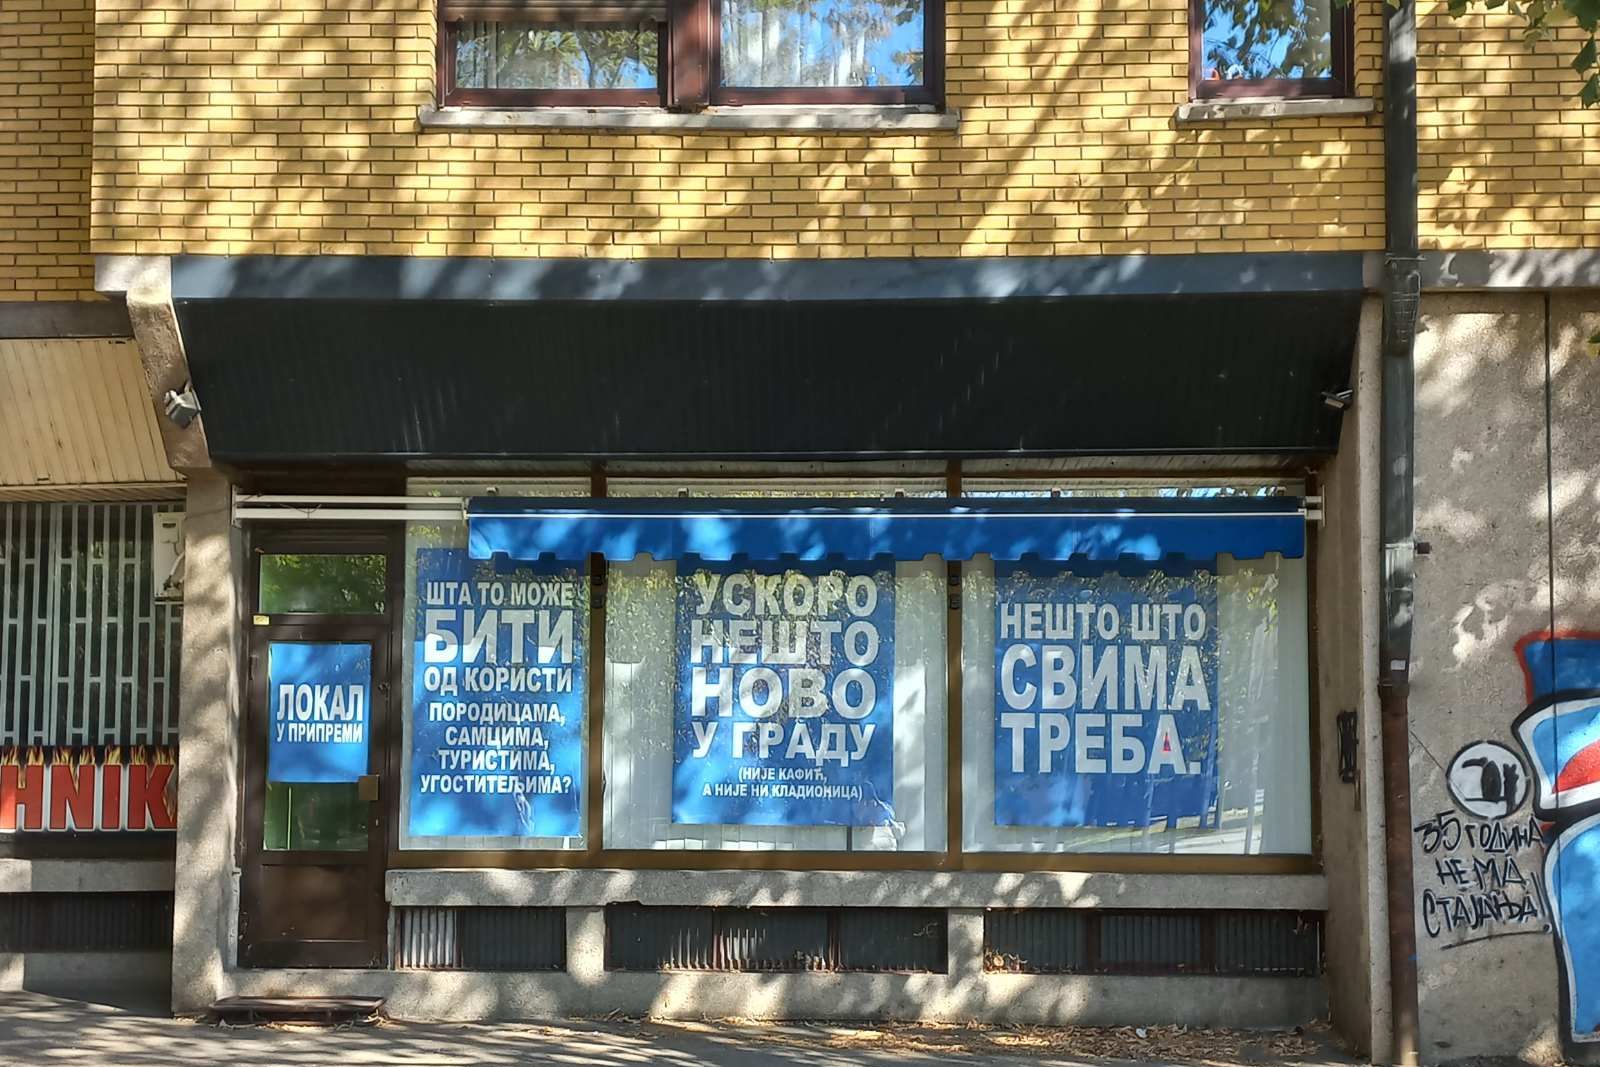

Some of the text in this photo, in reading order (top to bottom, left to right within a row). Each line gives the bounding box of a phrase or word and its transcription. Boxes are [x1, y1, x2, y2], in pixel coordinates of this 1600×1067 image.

[426, 581, 574, 606] ШТА ТО МОЖЕ
[694, 573, 878, 617] УСКОРО
[424, 609, 574, 664] БИТИ
[1000, 603, 1207, 641] НЕШТО ШТО
[690, 619, 880, 667] НЕШТО
[424, 666, 573, 697] ОД КОРИСТИ
[691, 667, 877, 719] НОВО
[1001, 643, 1211, 711] СВИМА
[276, 683, 364, 721] ЛОКАЛ
[429, 702, 567, 727] ПОРОДИЦАМА,
[276, 722, 363, 743] У ПРИПРЕМИ
[445, 726, 549, 750] САМЦИМА,
[691, 721, 876, 768] У ГРАДУ
[1000, 712, 1201, 775] ТРЕБА.
[438, 749, 555, 774] ТУРИСТИМА,
[738, 767, 828, 784] (НИЈЕ КАФИЋ,
[420, 774, 572, 794] УГОСТИТЕЉИМА?
[702, 784, 863, 801] А НИЈЕ НИ КЛАДИОНИЦА)
[1414, 810, 1462, 854] 35
[1434, 853, 1527, 891] НЕМА
